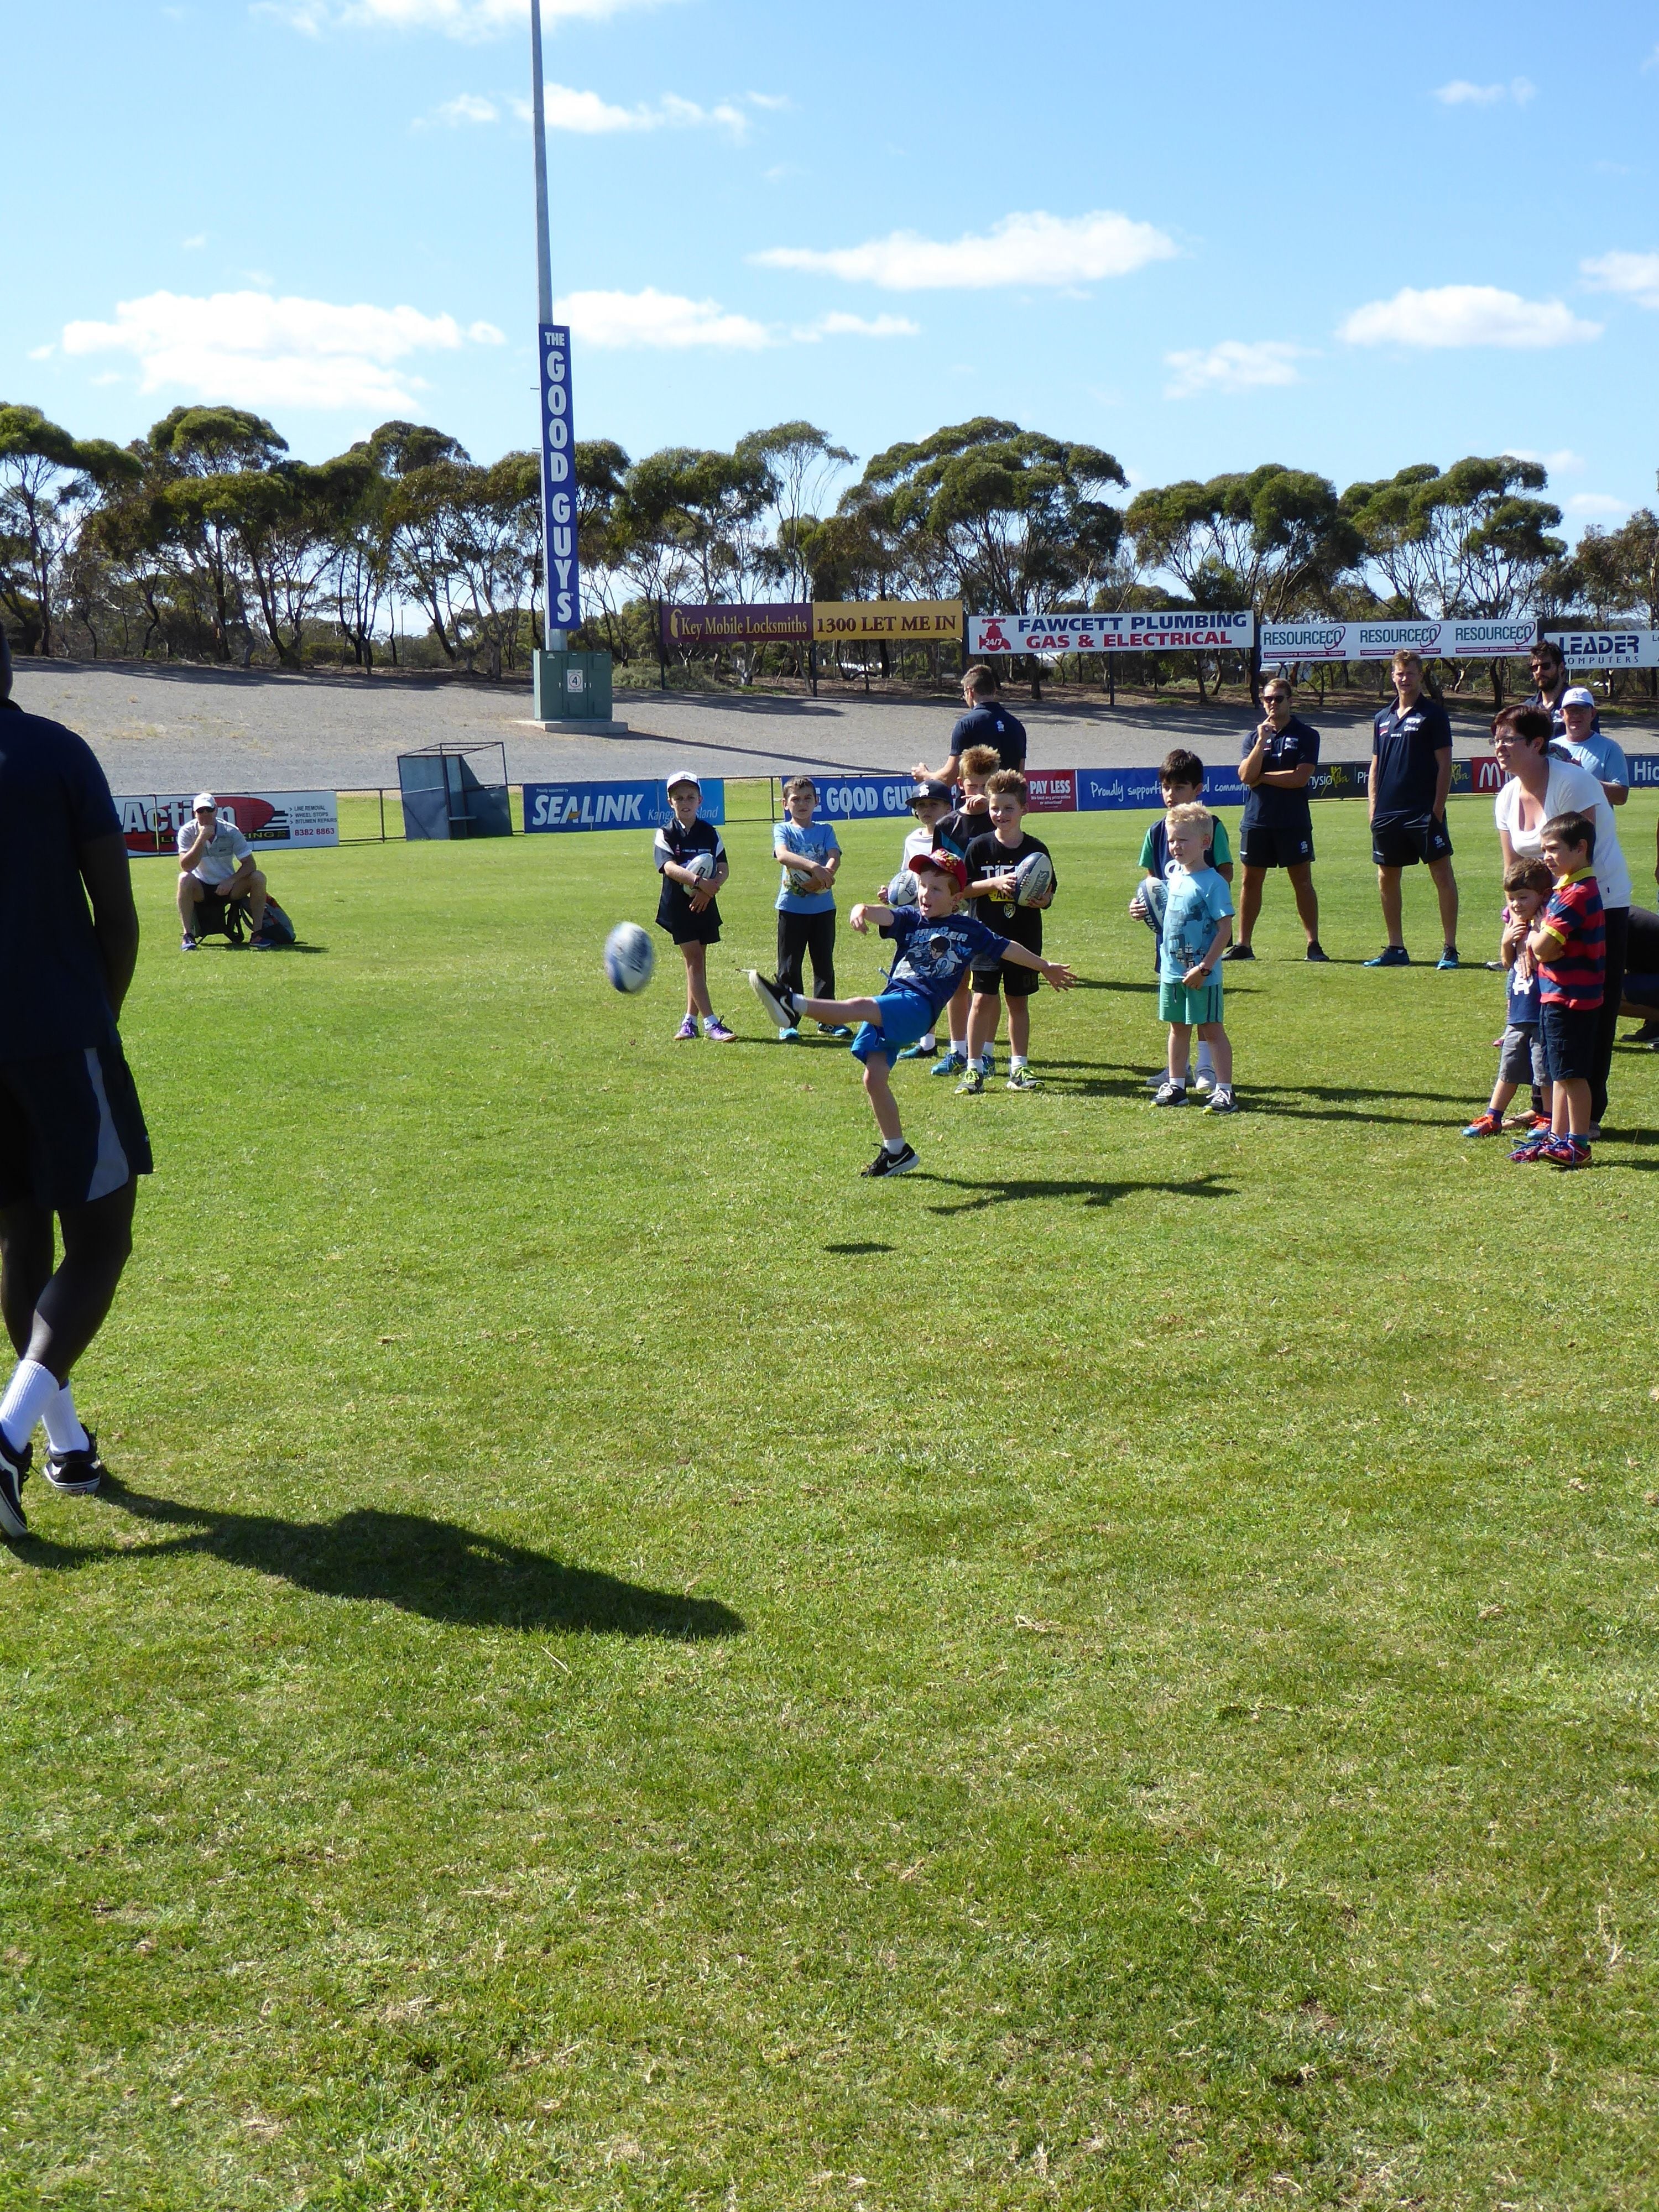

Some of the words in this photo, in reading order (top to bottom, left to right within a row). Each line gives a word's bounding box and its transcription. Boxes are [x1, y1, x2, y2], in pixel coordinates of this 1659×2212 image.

[545, 332, 565, 347] THE
[546, 351, 568, 483] GOOD
[552, 492, 572, 623] GUYS
[681, 616, 702, 640] Key
[705, 615, 743, 635] Mobile
[745, 613, 807, 634] Locksmiths
[817, 617, 857, 633] 1300
[861, 616, 896, 632] LET
[901, 615, 930, 631] ME
[935, 615, 956, 630] IN
[1018, 617, 1124, 633] FAWCETT
[1131, 613, 1247, 630] PLUMBING
[1026, 635, 1071, 649] GAS
[1078, 634, 1095, 648] &
[1103, 631, 1233, 648] ELECTRICAL
[1264, 628, 1343, 646] RESOURCECO
[1360, 627, 1438, 644] RESOURCECO
[1455, 624, 1532, 641] RESOURCECO
[1559, 635, 1639, 655] LEADER
[1564, 655, 1639, 665] OMPUTERS
[572, 676, 578, 685] 4
[1030, 780, 1048, 795] PAY
[1050, 780, 1071, 794] LESS
[1090, 779, 1124, 802] Proudly
[1127, 782, 1162, 801] supporti
[826, 786, 879, 813] GOOD
[883, 785, 918, 811] GUY
[123, 800, 236, 833] Actin
[533, 794, 644, 826] SEALINK
[648, 809, 675, 823] Kanga
[696, 806, 718, 818] sland
